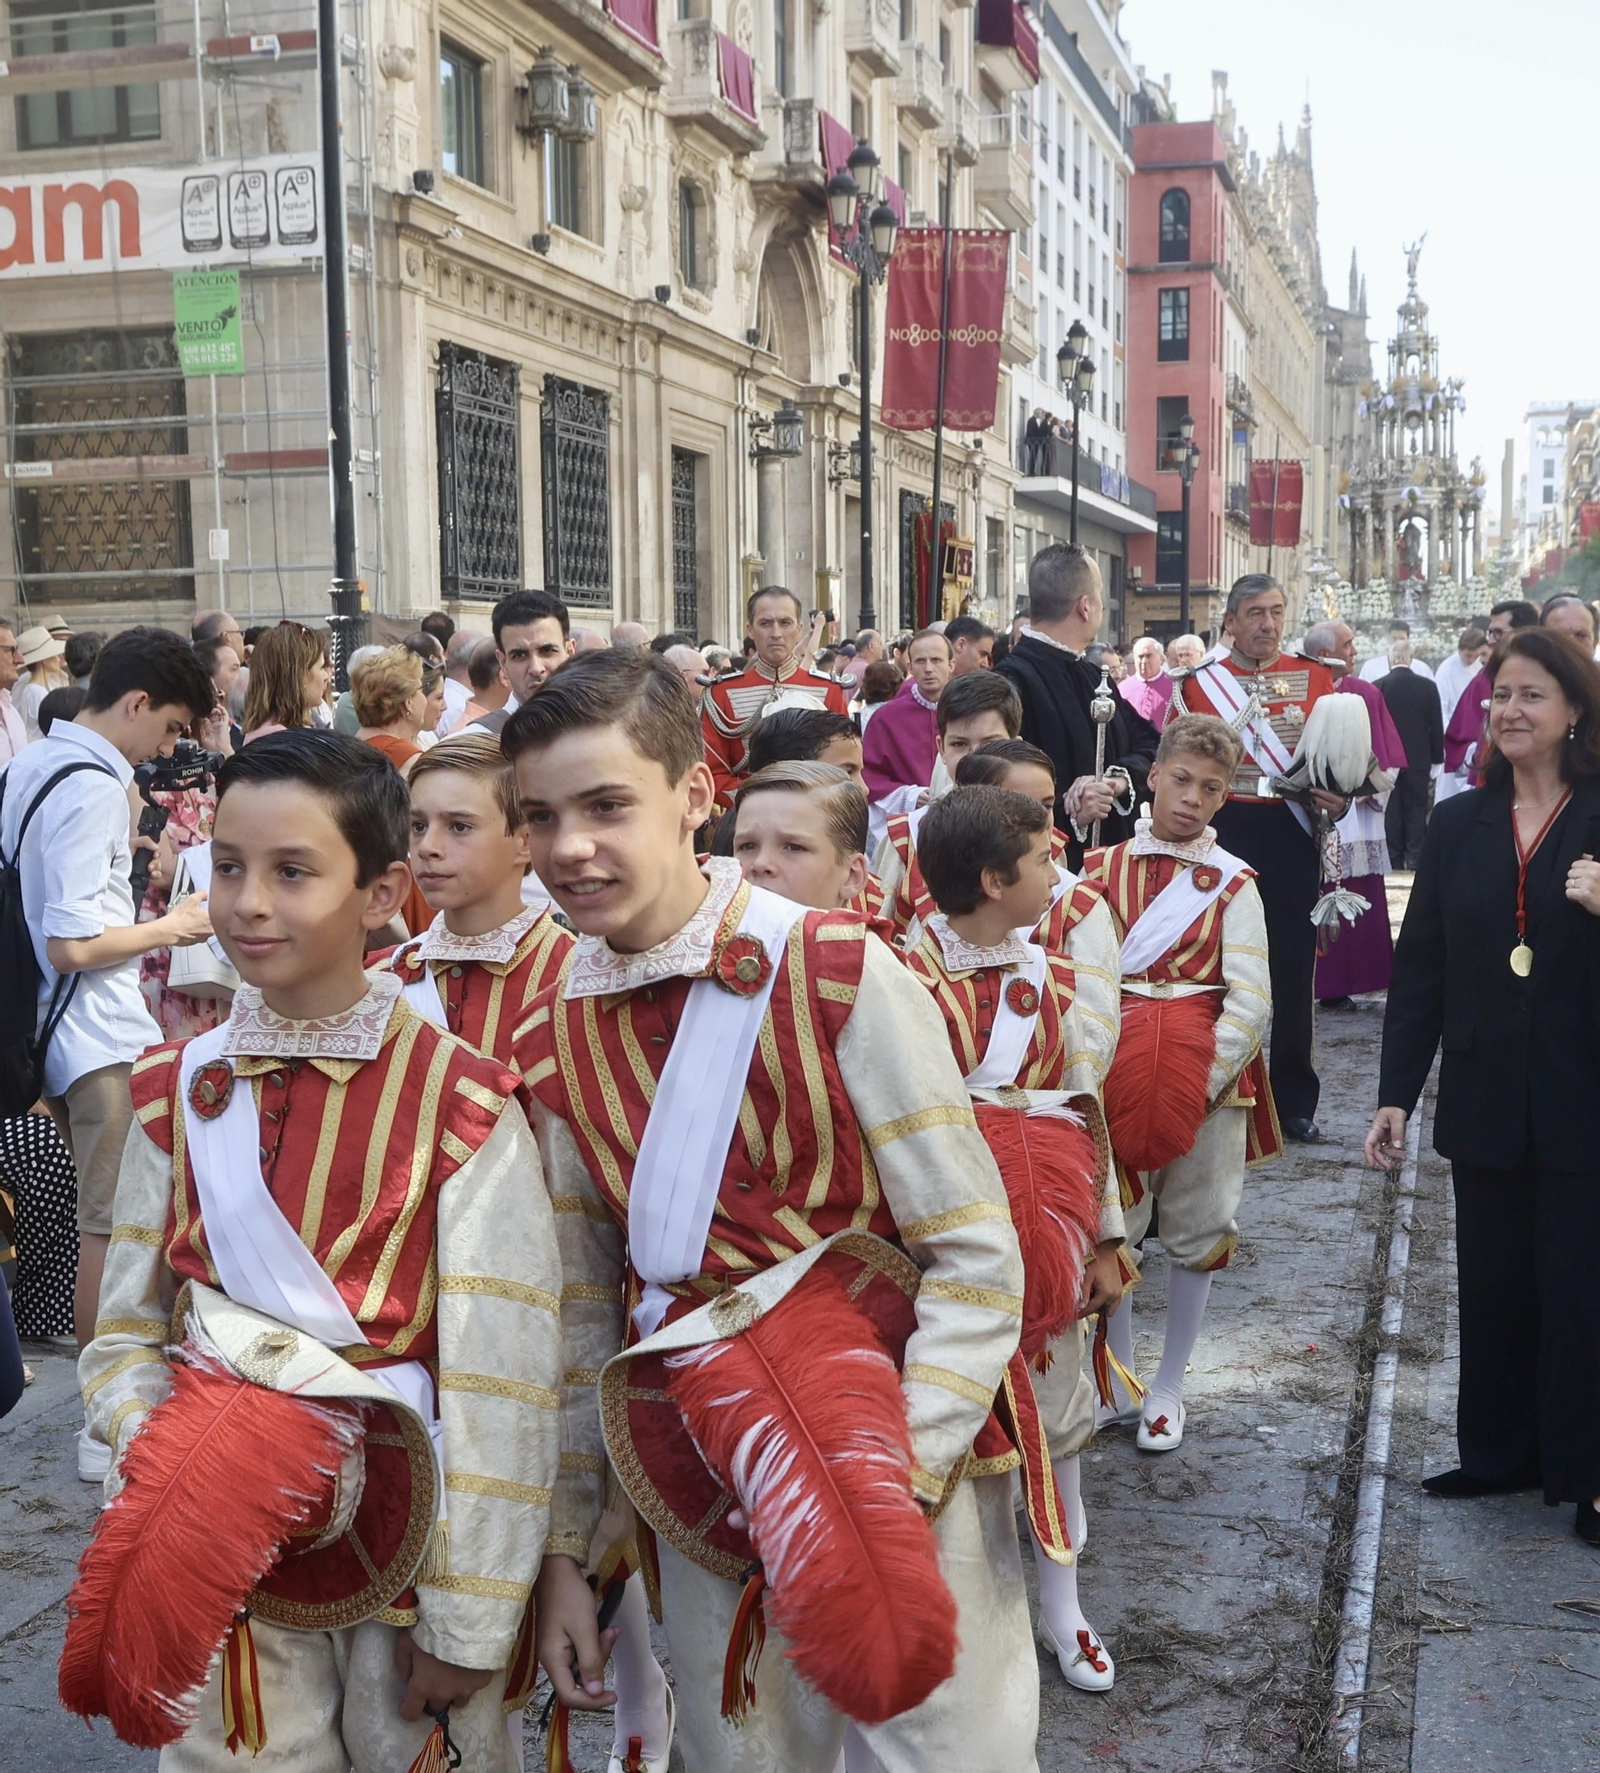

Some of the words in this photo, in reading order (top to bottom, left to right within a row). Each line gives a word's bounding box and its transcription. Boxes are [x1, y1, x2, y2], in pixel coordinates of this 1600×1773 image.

[175, 272, 237, 287] ATENCIÓN
[177, 320, 221, 333] VENTO
[181, 766, 204, 777] RONIN
